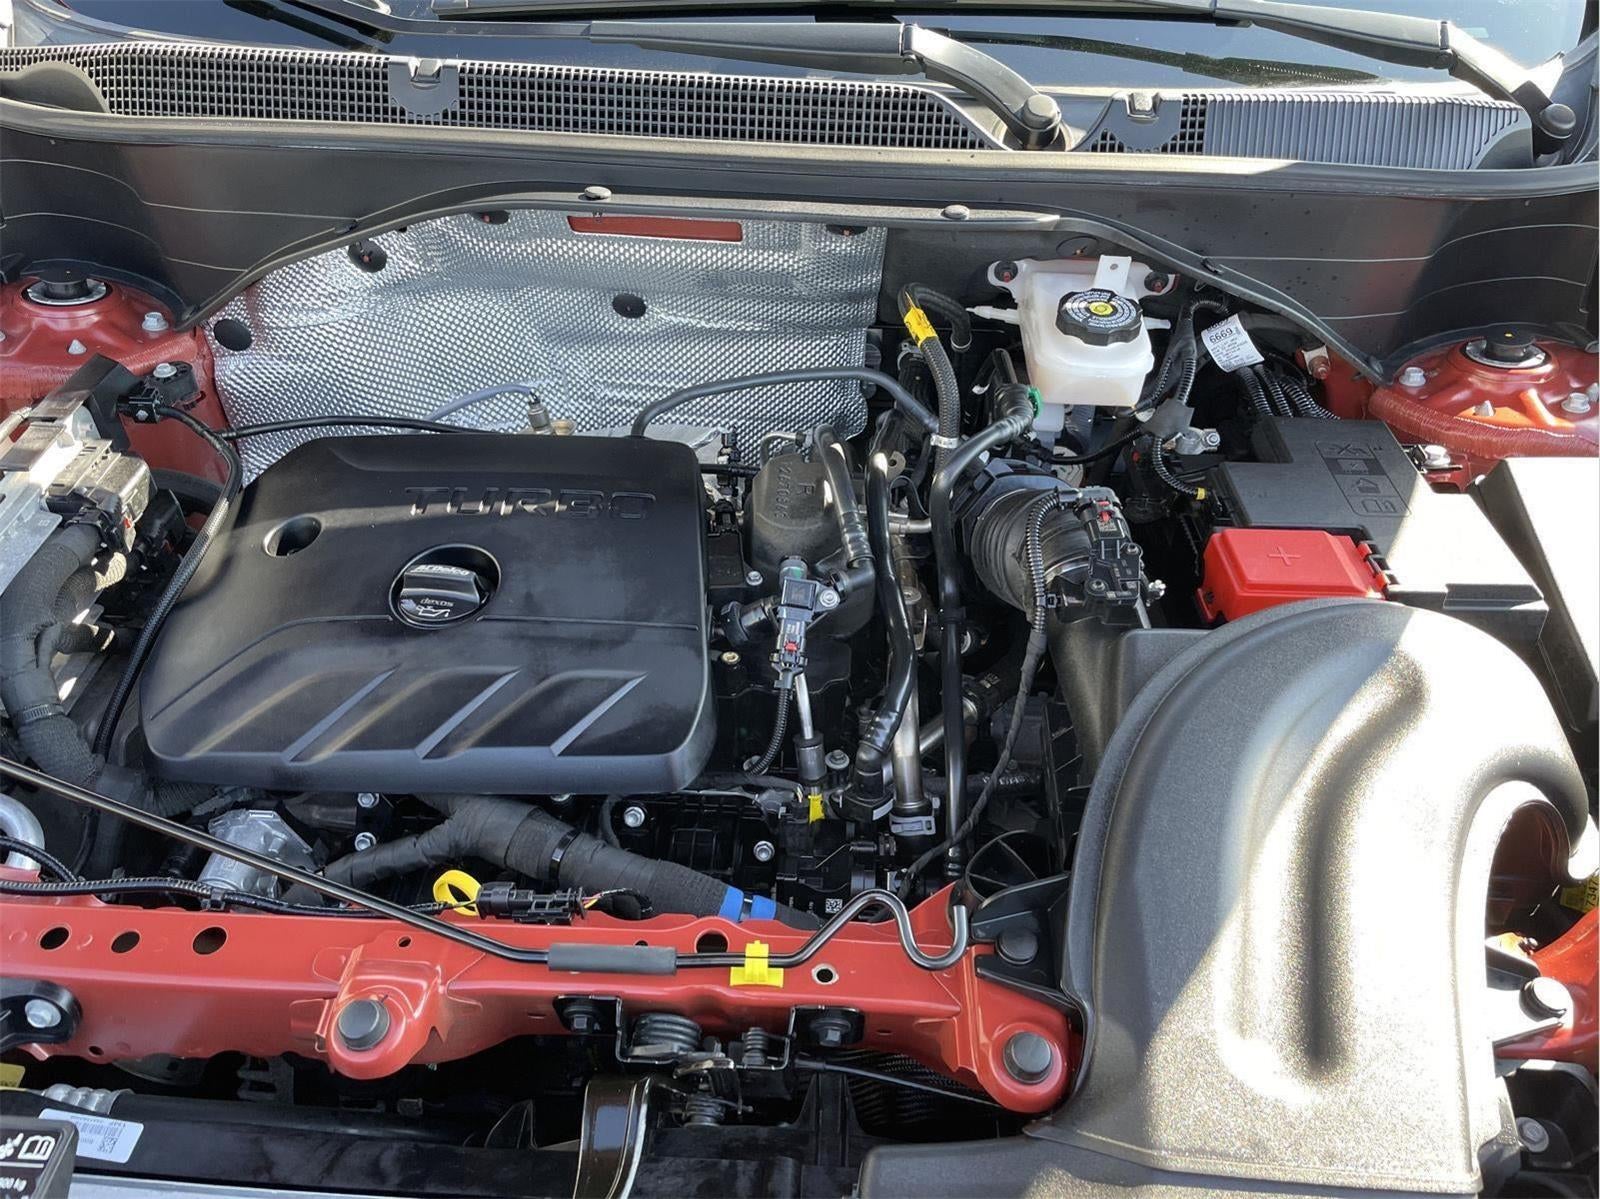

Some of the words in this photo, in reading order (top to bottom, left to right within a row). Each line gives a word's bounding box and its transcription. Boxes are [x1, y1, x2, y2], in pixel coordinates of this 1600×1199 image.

[1209, 327, 1233, 344] 6669
[797, 482, 816, 496] R
[404, 487, 657, 520] TURBO
[410, 564, 471, 576] ACDelco
[420, 597, 455, 607] dexos
